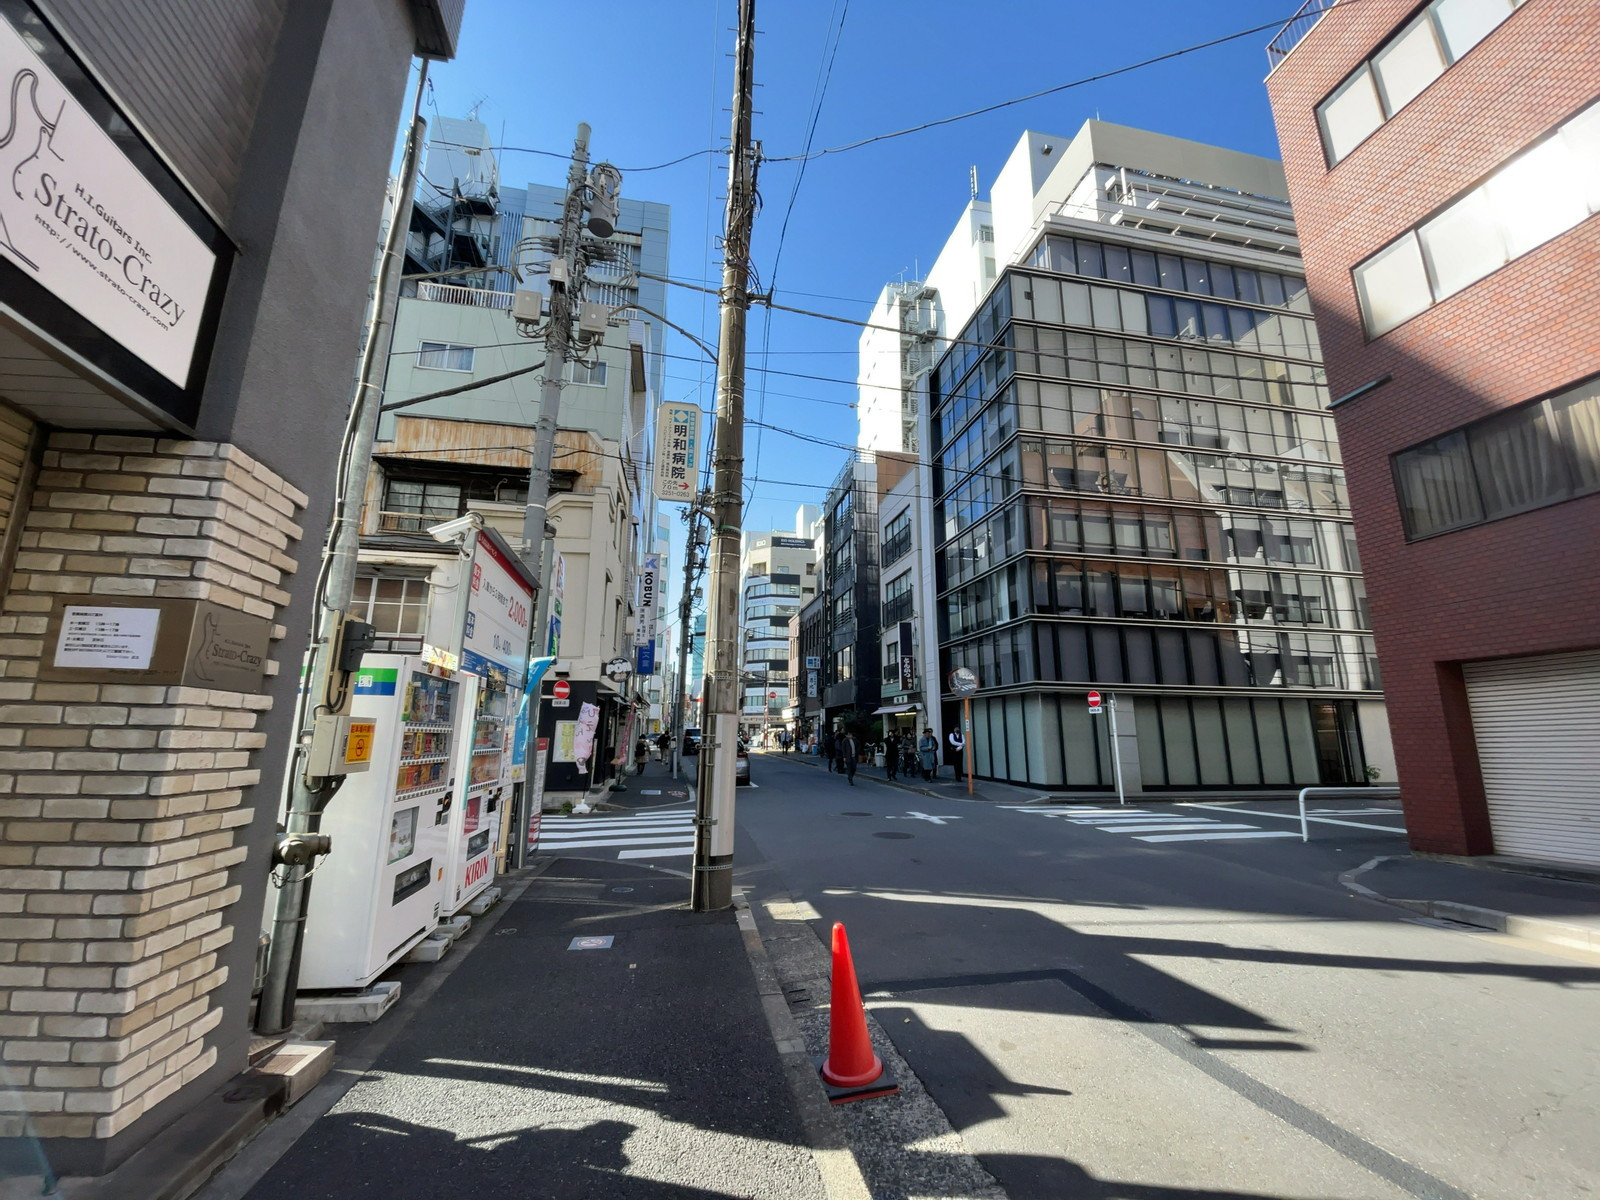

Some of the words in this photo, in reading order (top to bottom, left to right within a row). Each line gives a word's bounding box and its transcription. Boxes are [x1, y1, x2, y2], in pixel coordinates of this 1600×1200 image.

[75, 183, 133, 246] H.I.Guitars
[134, 239, 153, 264] Inc.
[34, 172, 186, 327] Strato-Crazy
[35, 214, 169, 331] http://www.strato-crazy.com
[671, 424, 687, 479] 明和病院
[661, 489, 689, 498] 3251-0263
[642, 571, 653, 607] KOBUN
[212, 644, 262, 667] Strato-Crazy
[465, 855, 488, 889] KIRIN
